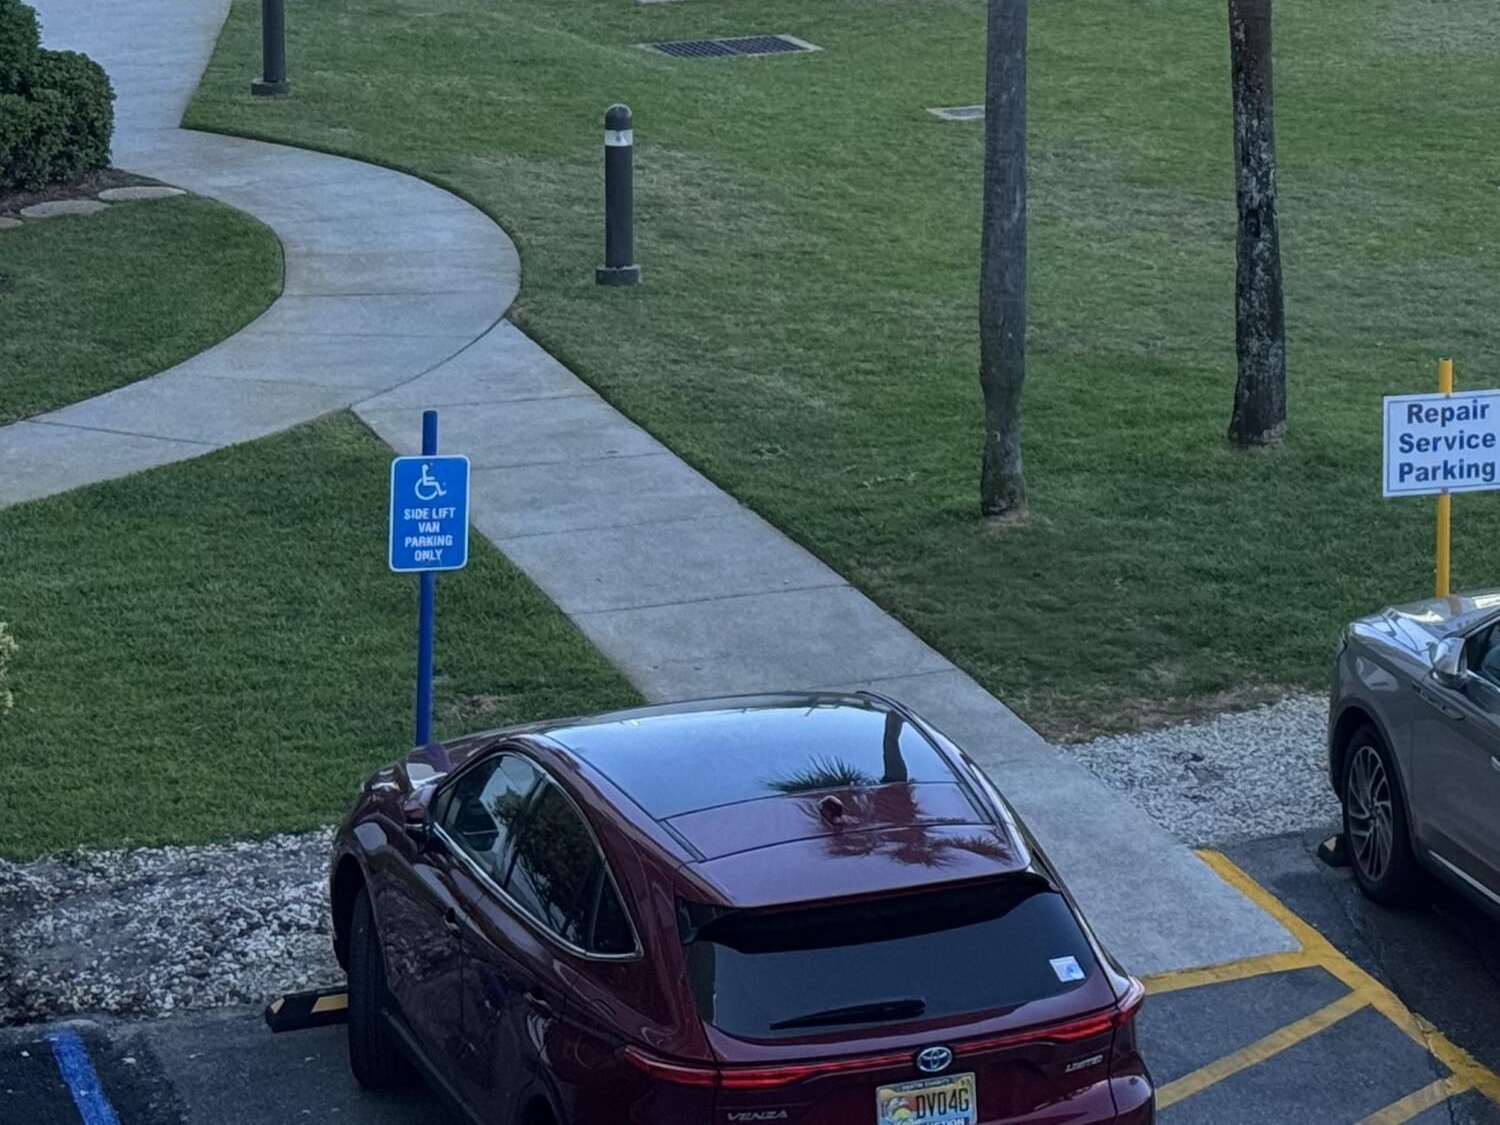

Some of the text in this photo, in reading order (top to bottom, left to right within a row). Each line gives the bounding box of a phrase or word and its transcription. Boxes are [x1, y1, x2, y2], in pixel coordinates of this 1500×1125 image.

[1407, 399, 1489, 427] Repair
[1399, 430, 1496, 454] Service
[1398, 459, 1496, 483] Parking
[404, 507, 456, 520] SIDE LIFT
[418, 521, 440, 533] VAN
[405, 535, 453, 548] PARKING
[414, 549, 443, 562] ONLY
[727, 1109, 788, 1121] VENZA
